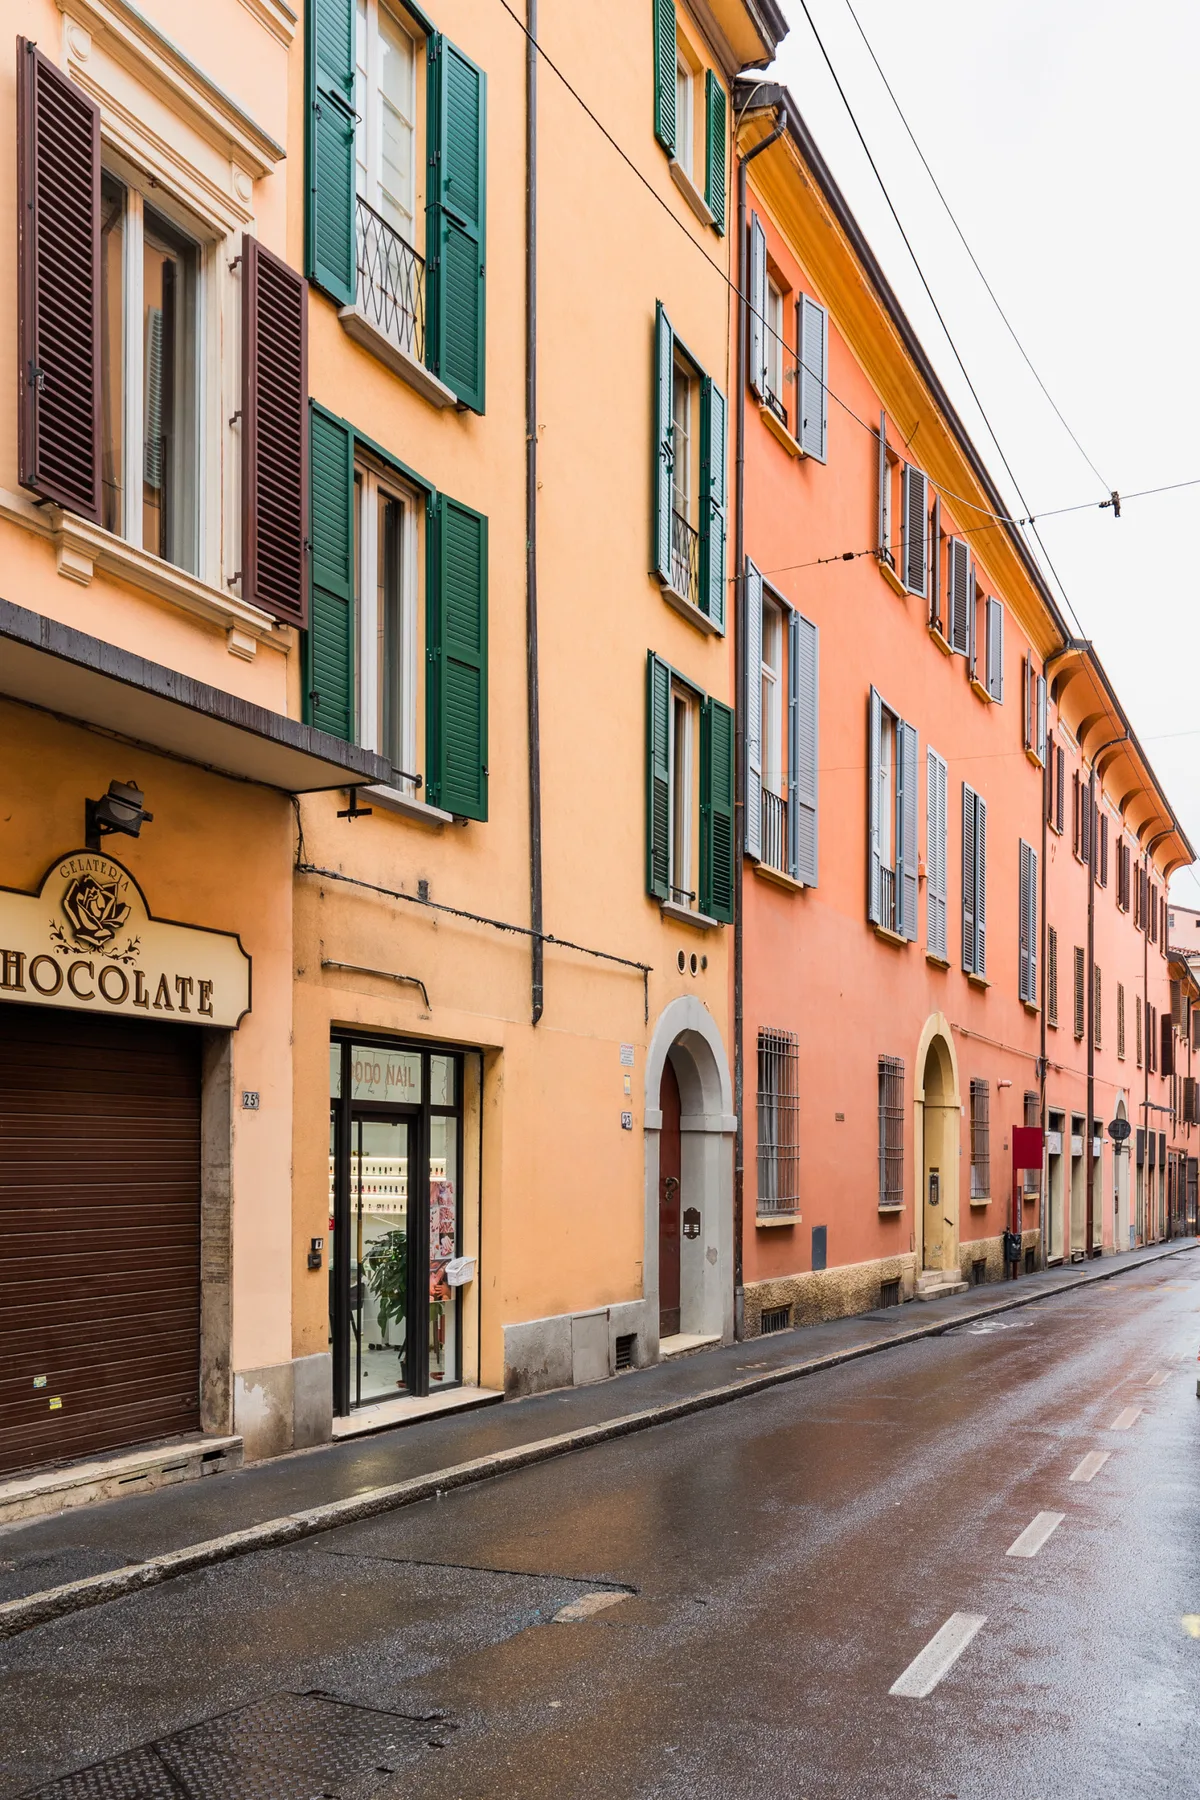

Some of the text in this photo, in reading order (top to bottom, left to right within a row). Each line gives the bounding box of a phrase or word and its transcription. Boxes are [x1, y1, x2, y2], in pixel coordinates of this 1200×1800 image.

[59, 858, 130, 892] GELATERIA
[0, 949, 214, 1018] HOCOLATE
[386, 1063, 416, 1088] NAIL
